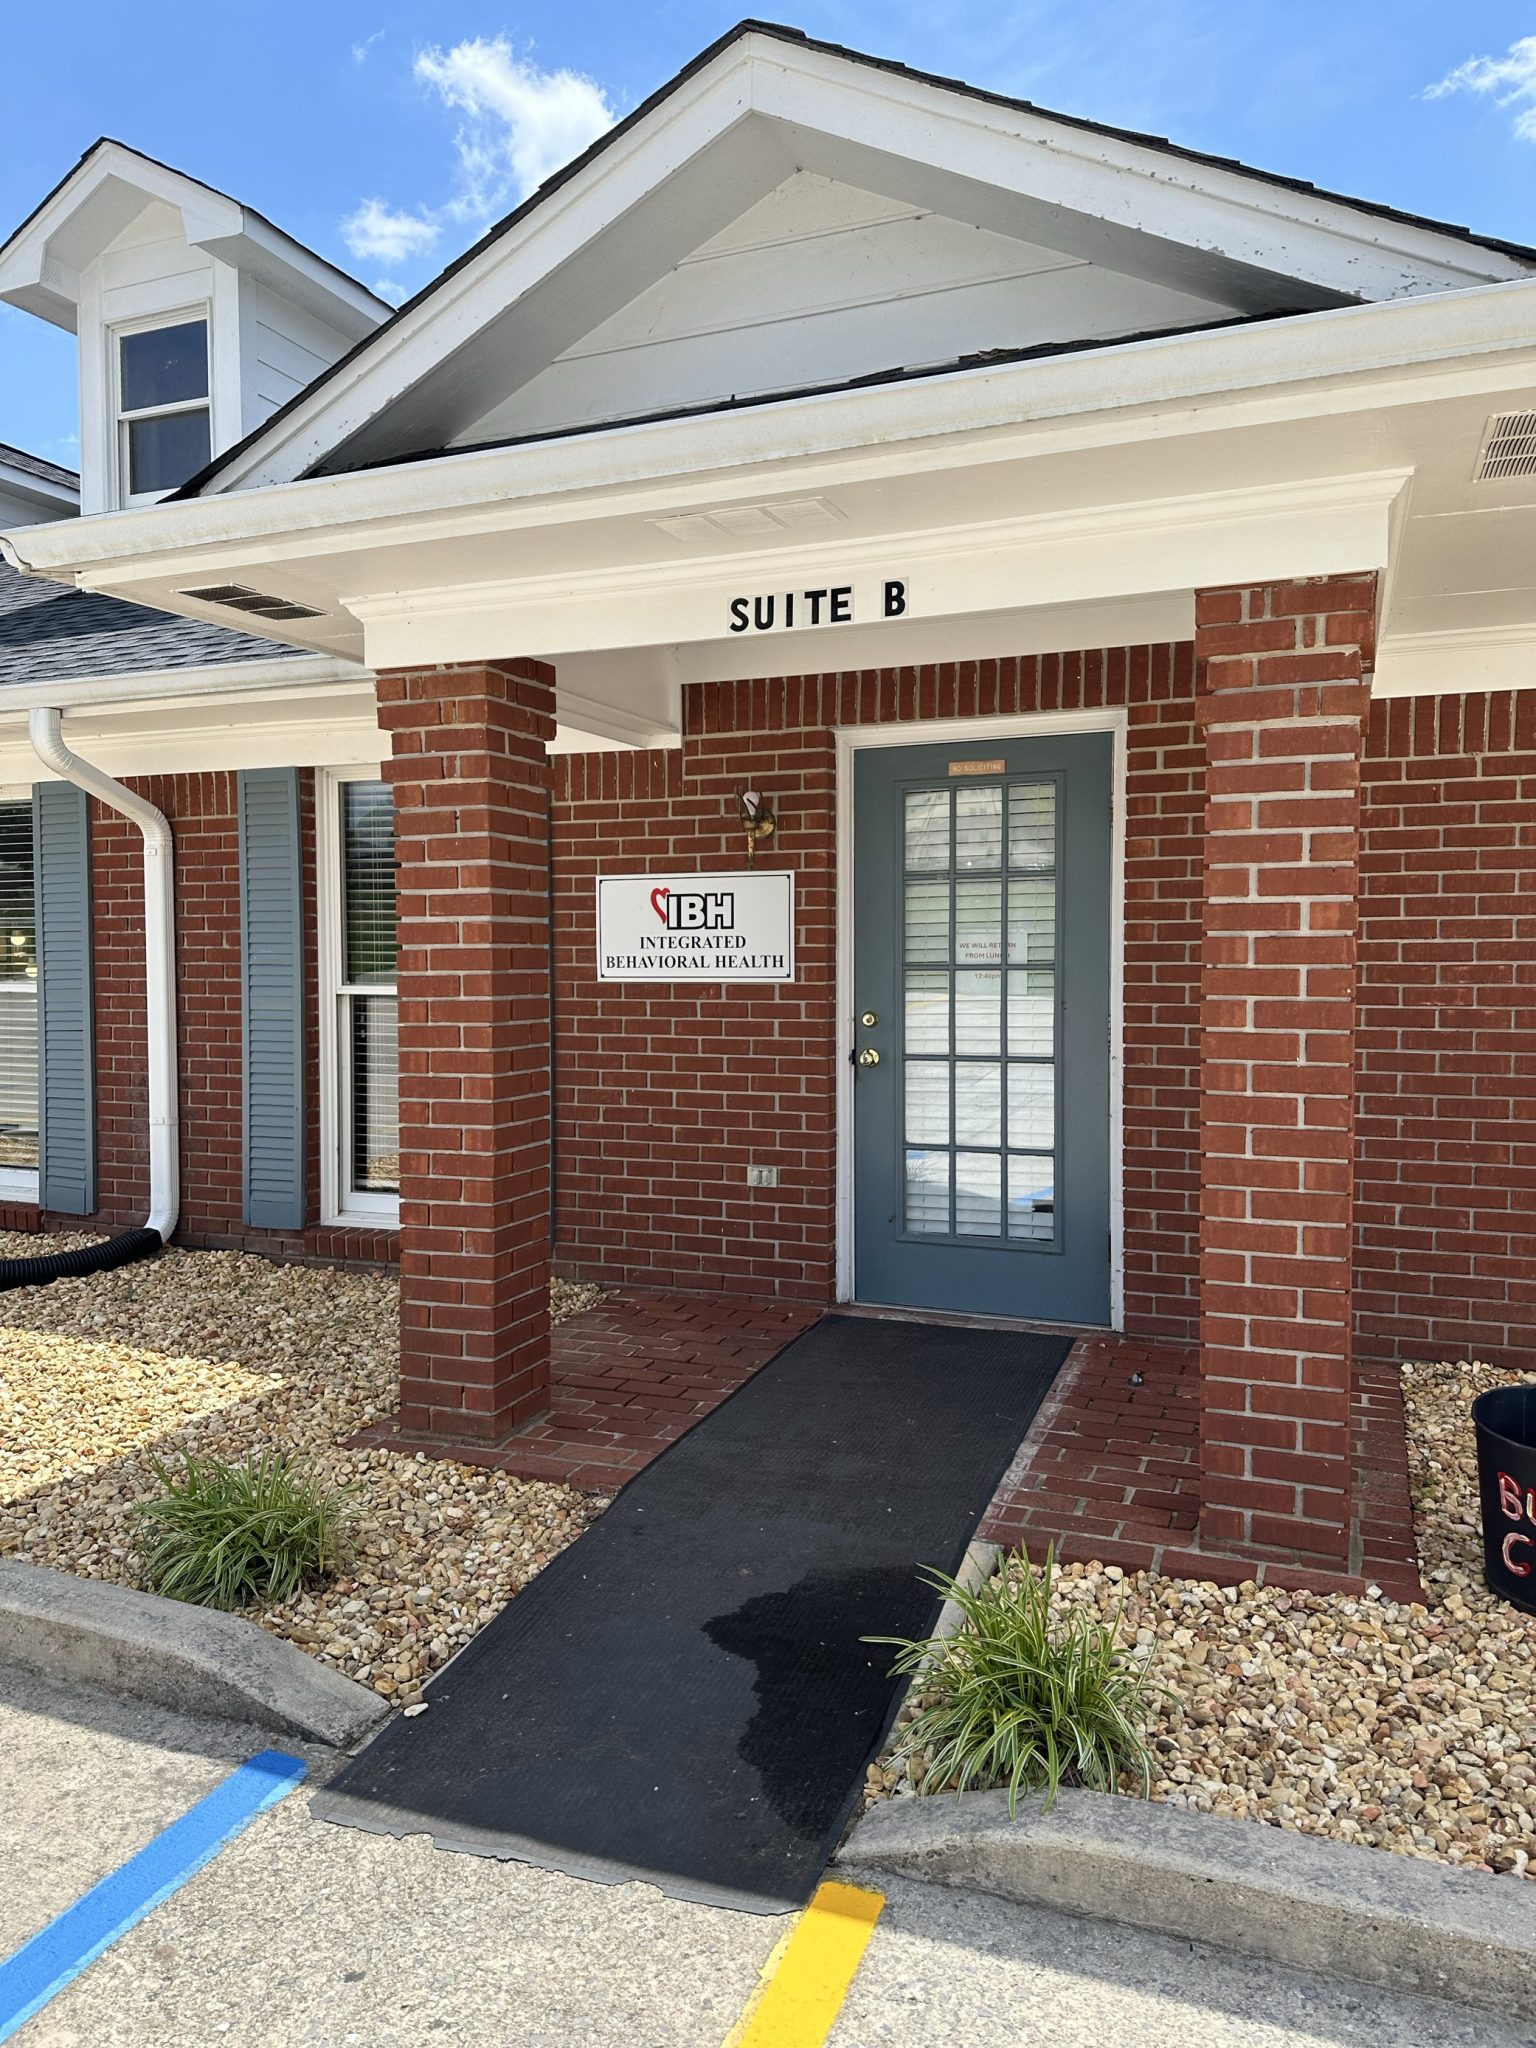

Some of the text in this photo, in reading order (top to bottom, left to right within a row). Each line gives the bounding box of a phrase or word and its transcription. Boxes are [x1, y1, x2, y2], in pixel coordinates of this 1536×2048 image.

[729, 580, 906, 632] SUITE B
[952, 762, 1001, 772] NO SOLICITING
[666, 892, 735, 930] IBH
[639, 935, 747, 950] INTEGRATED
[606, 954, 784, 969] BEHAVIORAL HEALTH
